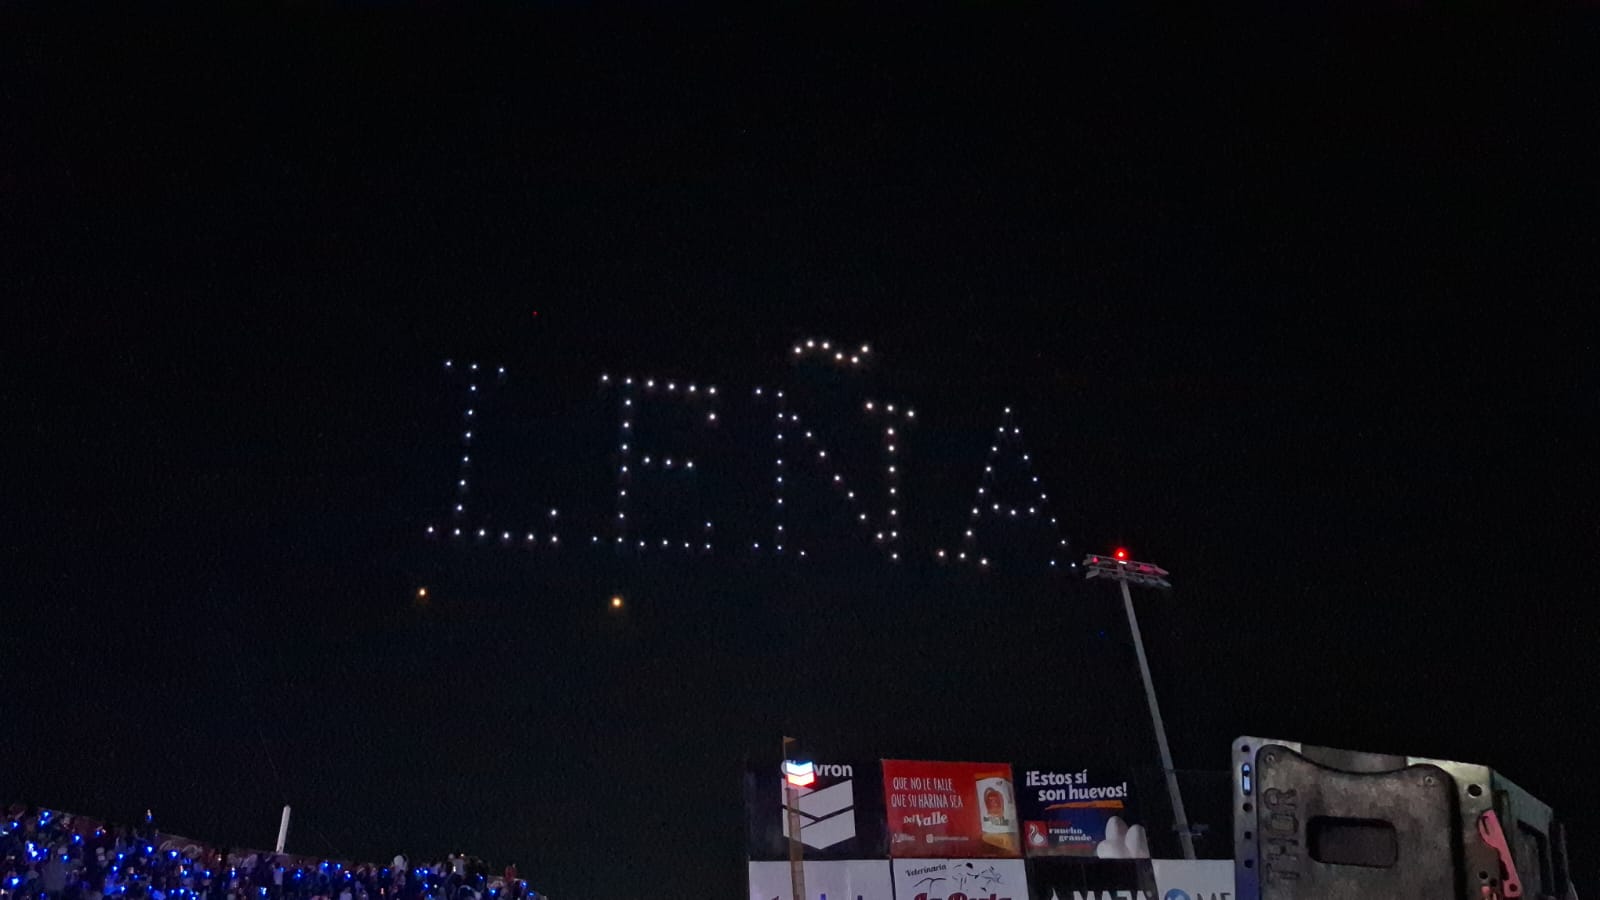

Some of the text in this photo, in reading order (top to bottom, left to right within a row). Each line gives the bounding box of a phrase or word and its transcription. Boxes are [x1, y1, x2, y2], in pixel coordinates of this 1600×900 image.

[893, 777, 908, 791] QUE
[910, 777, 922, 791] NO
[923, 778, 932, 791] LE
[1026, 769, 1088, 787] ¡Estos sí
[1038, 782, 1127, 801] son huevos!
[891, 794, 964, 808] QUE SU HARINA SEA
[915, 811, 948, 828] Valle
[1058, 834, 1092, 842] grande
[905, 864, 947, 877] Veterinaria
